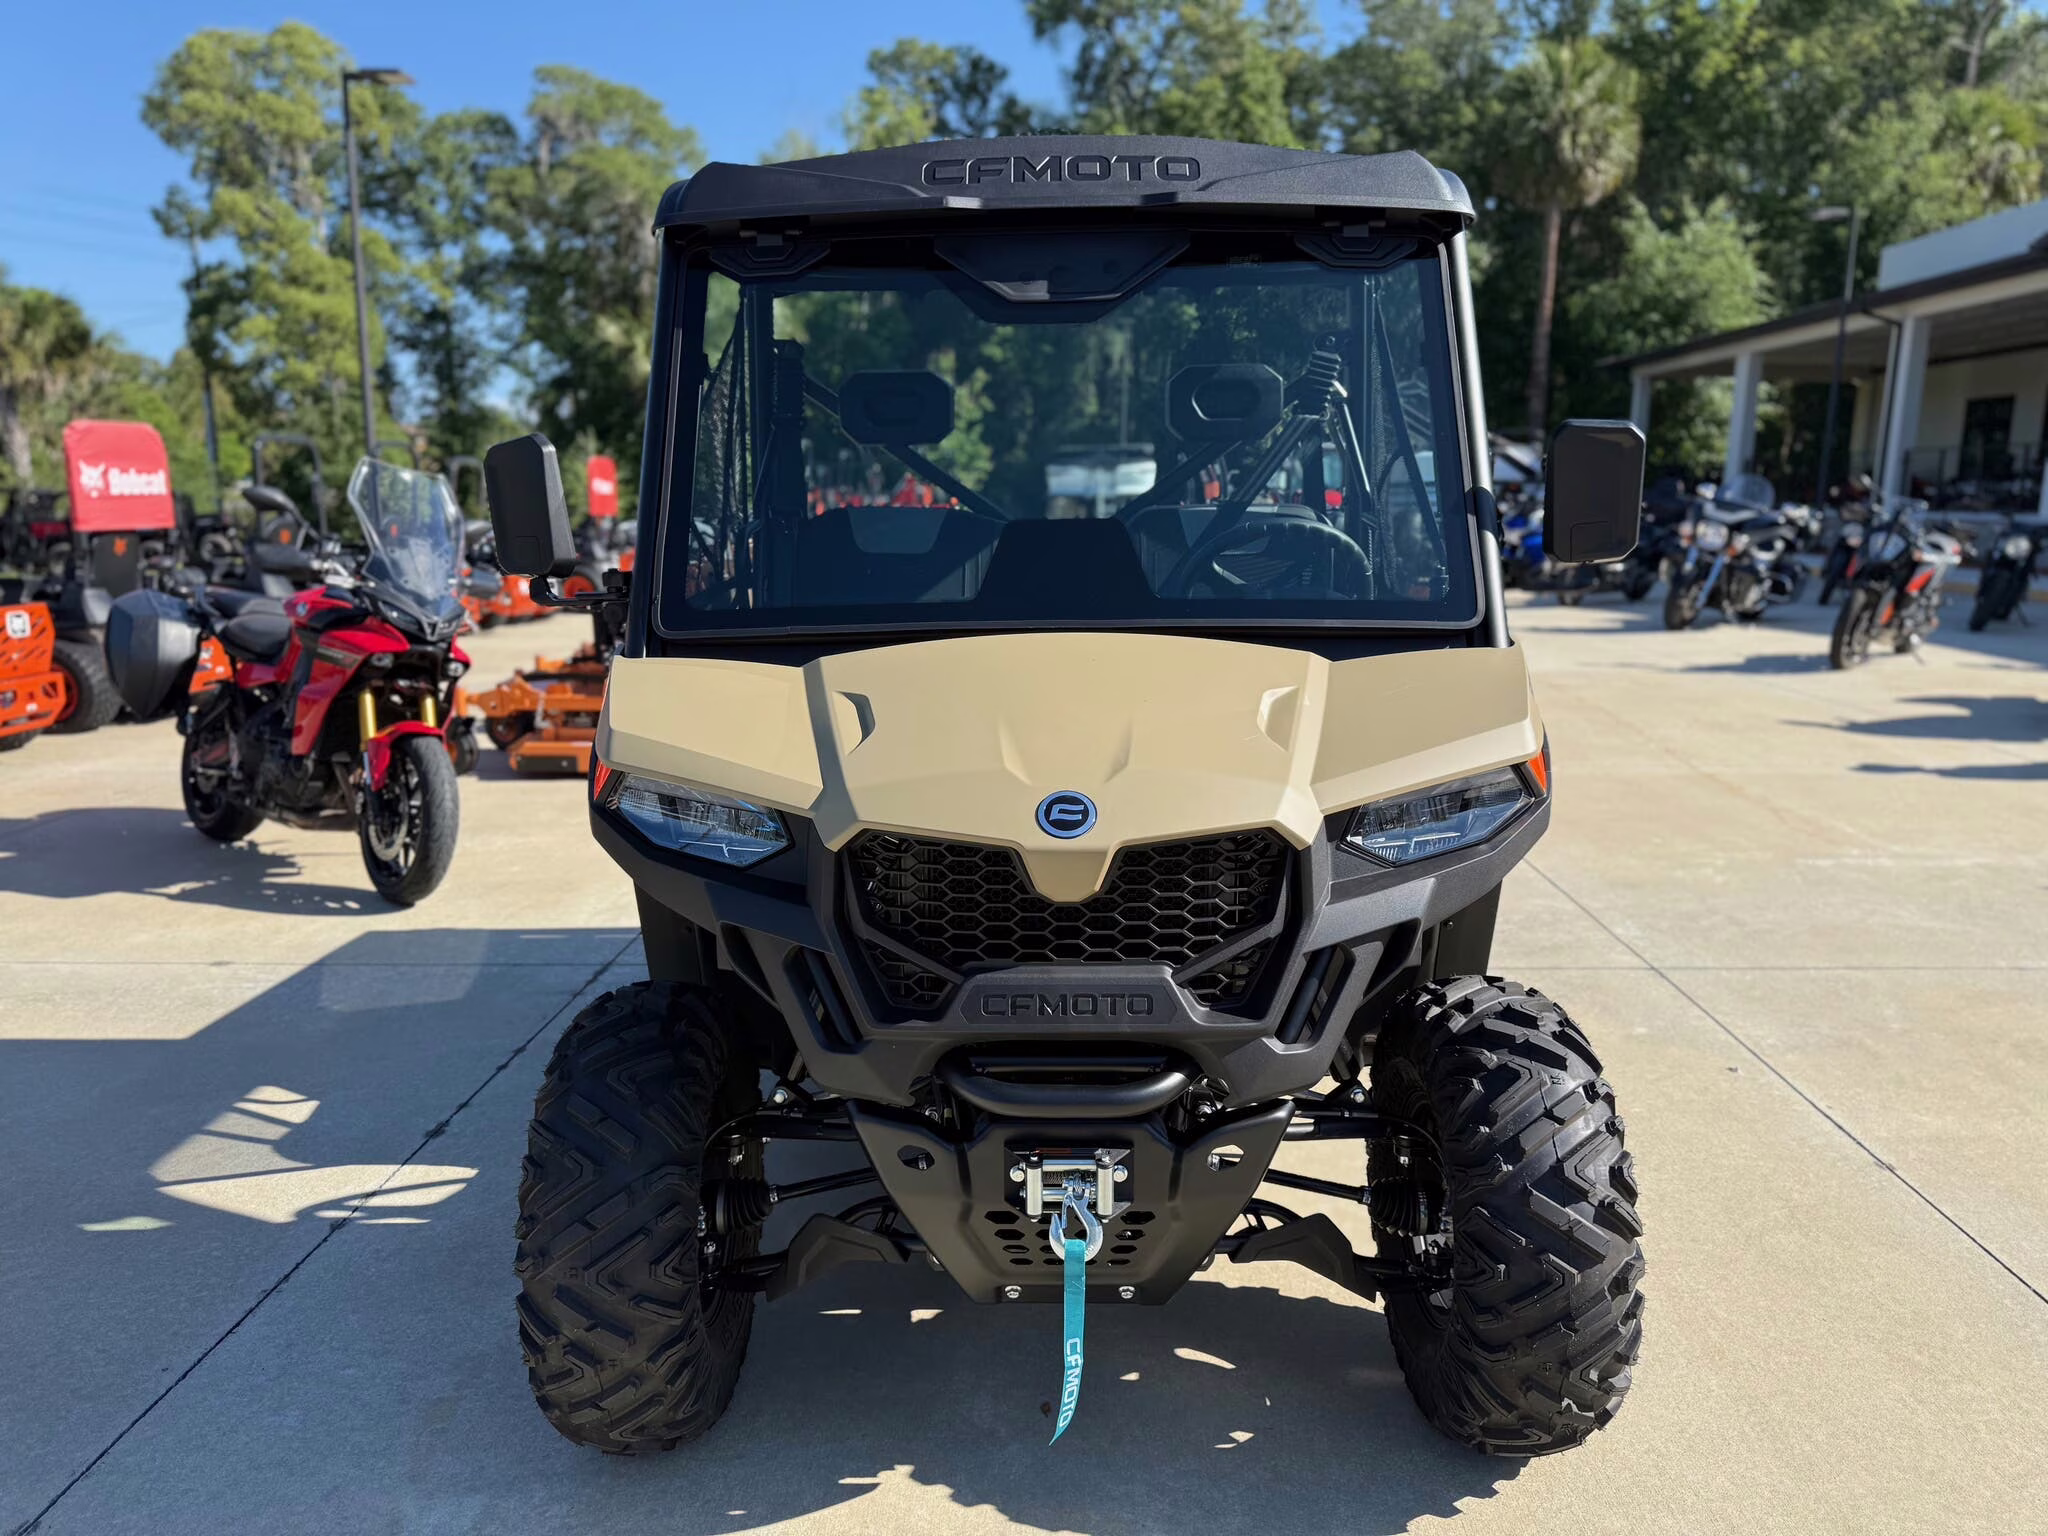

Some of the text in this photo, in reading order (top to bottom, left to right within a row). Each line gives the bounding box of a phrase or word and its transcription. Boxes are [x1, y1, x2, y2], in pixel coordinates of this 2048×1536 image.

[921, 155, 1201, 186] CFMOTO
[108, 467, 167, 496] Bobcat
[981, 993, 1154, 1017] CFMOTO
[1058, 1338, 1082, 1427] CFMOTO
